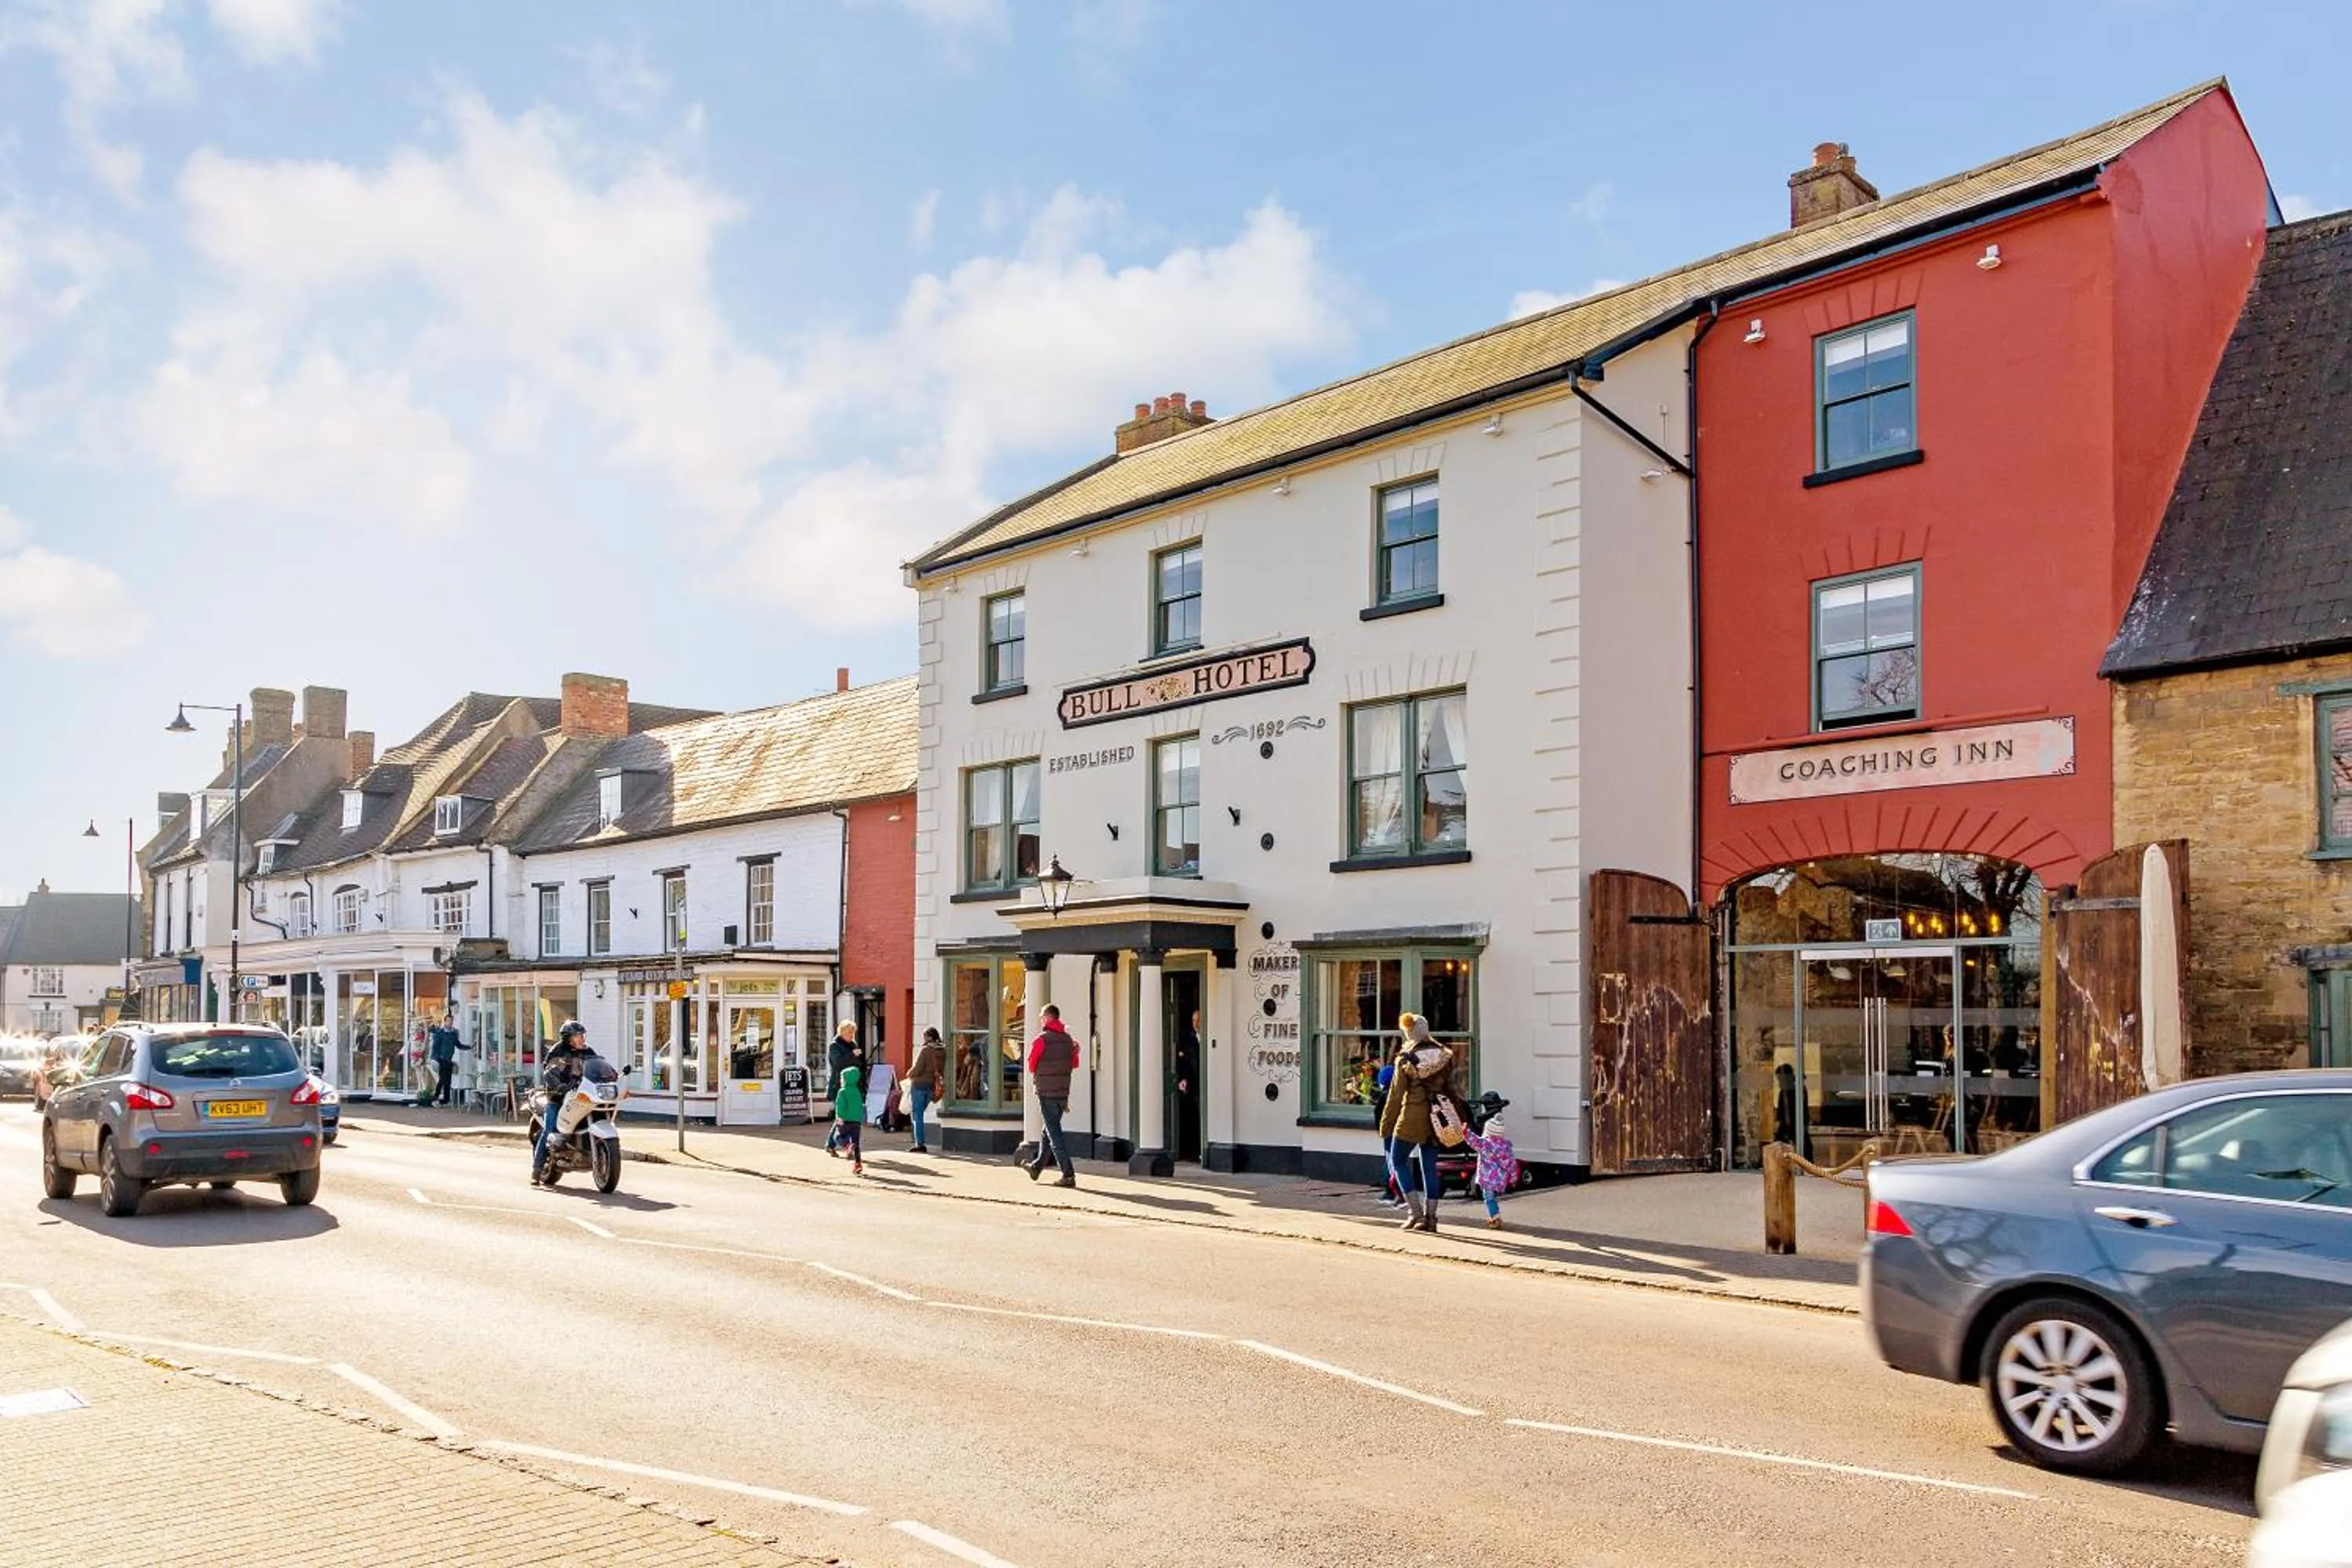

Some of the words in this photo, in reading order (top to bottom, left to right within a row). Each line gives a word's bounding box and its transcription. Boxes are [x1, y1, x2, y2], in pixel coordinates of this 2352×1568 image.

[1070, 684, 1141, 720] BULL
[1192, 650, 1298, 695] HOTEL
[1049, 746, 1134, 773] ESTABLISHED
[1250, 719, 1284, 741] 1692
[1779, 747, 1938, 782] COACHING
[1955, 739, 2013, 765] INN
[1253, 956, 1301, 974] MAKER
[1271, 984, 1289, 999] OF
[1264, 1023, 1298, 1039] FINE
